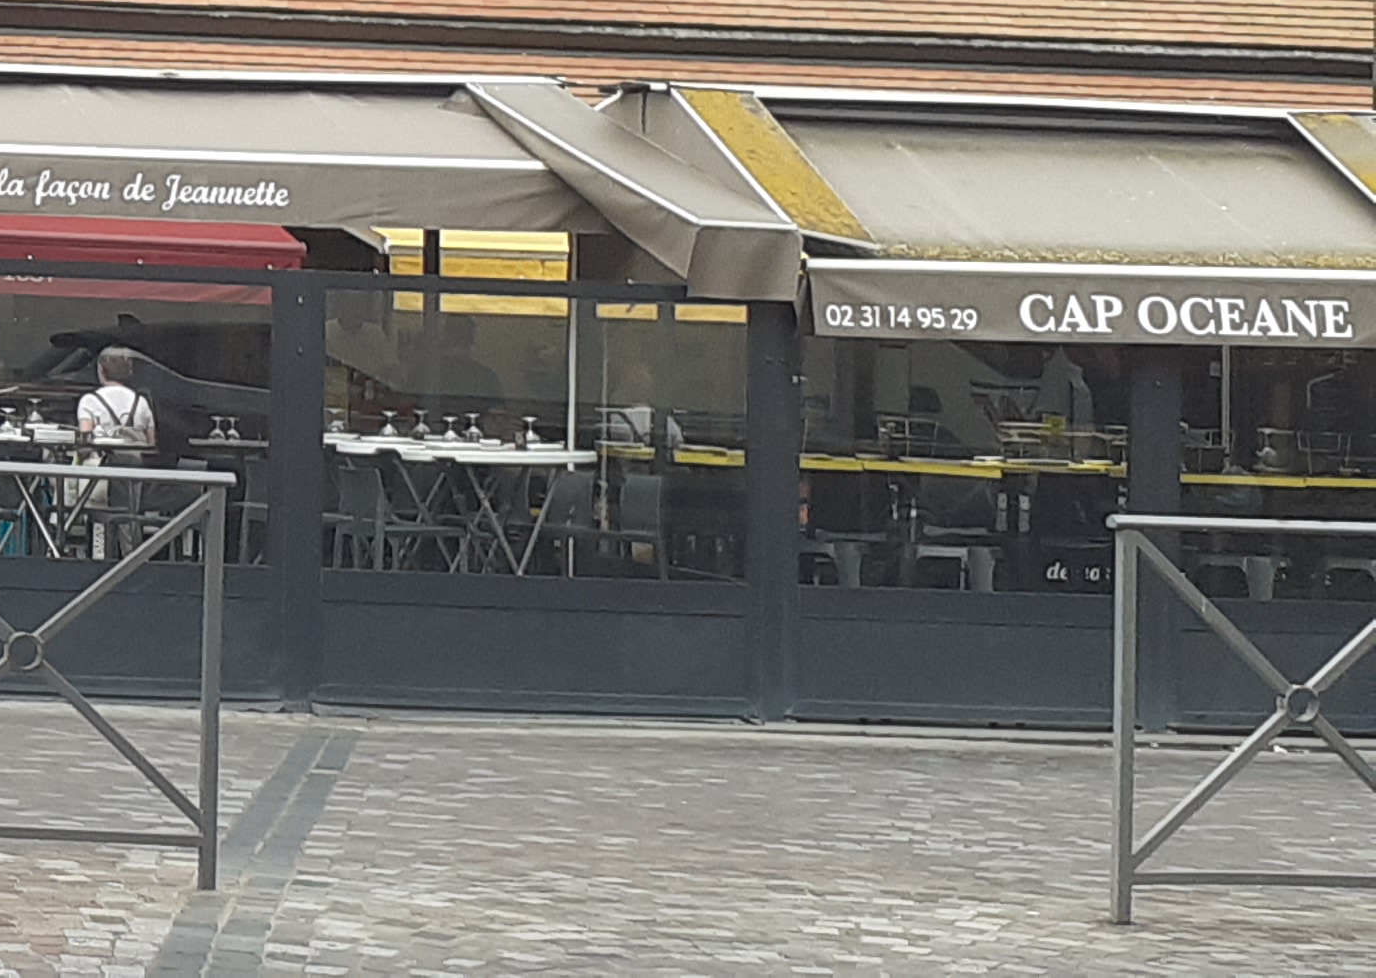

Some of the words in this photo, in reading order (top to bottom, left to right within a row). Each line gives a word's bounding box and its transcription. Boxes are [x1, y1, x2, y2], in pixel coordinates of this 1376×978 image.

[34, 169, 111, 206] façon
[123, 172, 156, 202] de
[161, 174, 290, 212] Jeannette
[825, 304, 855, 327] 02
[859, 305, 881, 328] 31
[887, 305, 912, 328] 14
[916, 307, 945, 329] 95
[950, 308, 978, 330] 29
[1019, 293, 1123, 333] CAP
[1138, 296, 1353, 338] OCEANE
